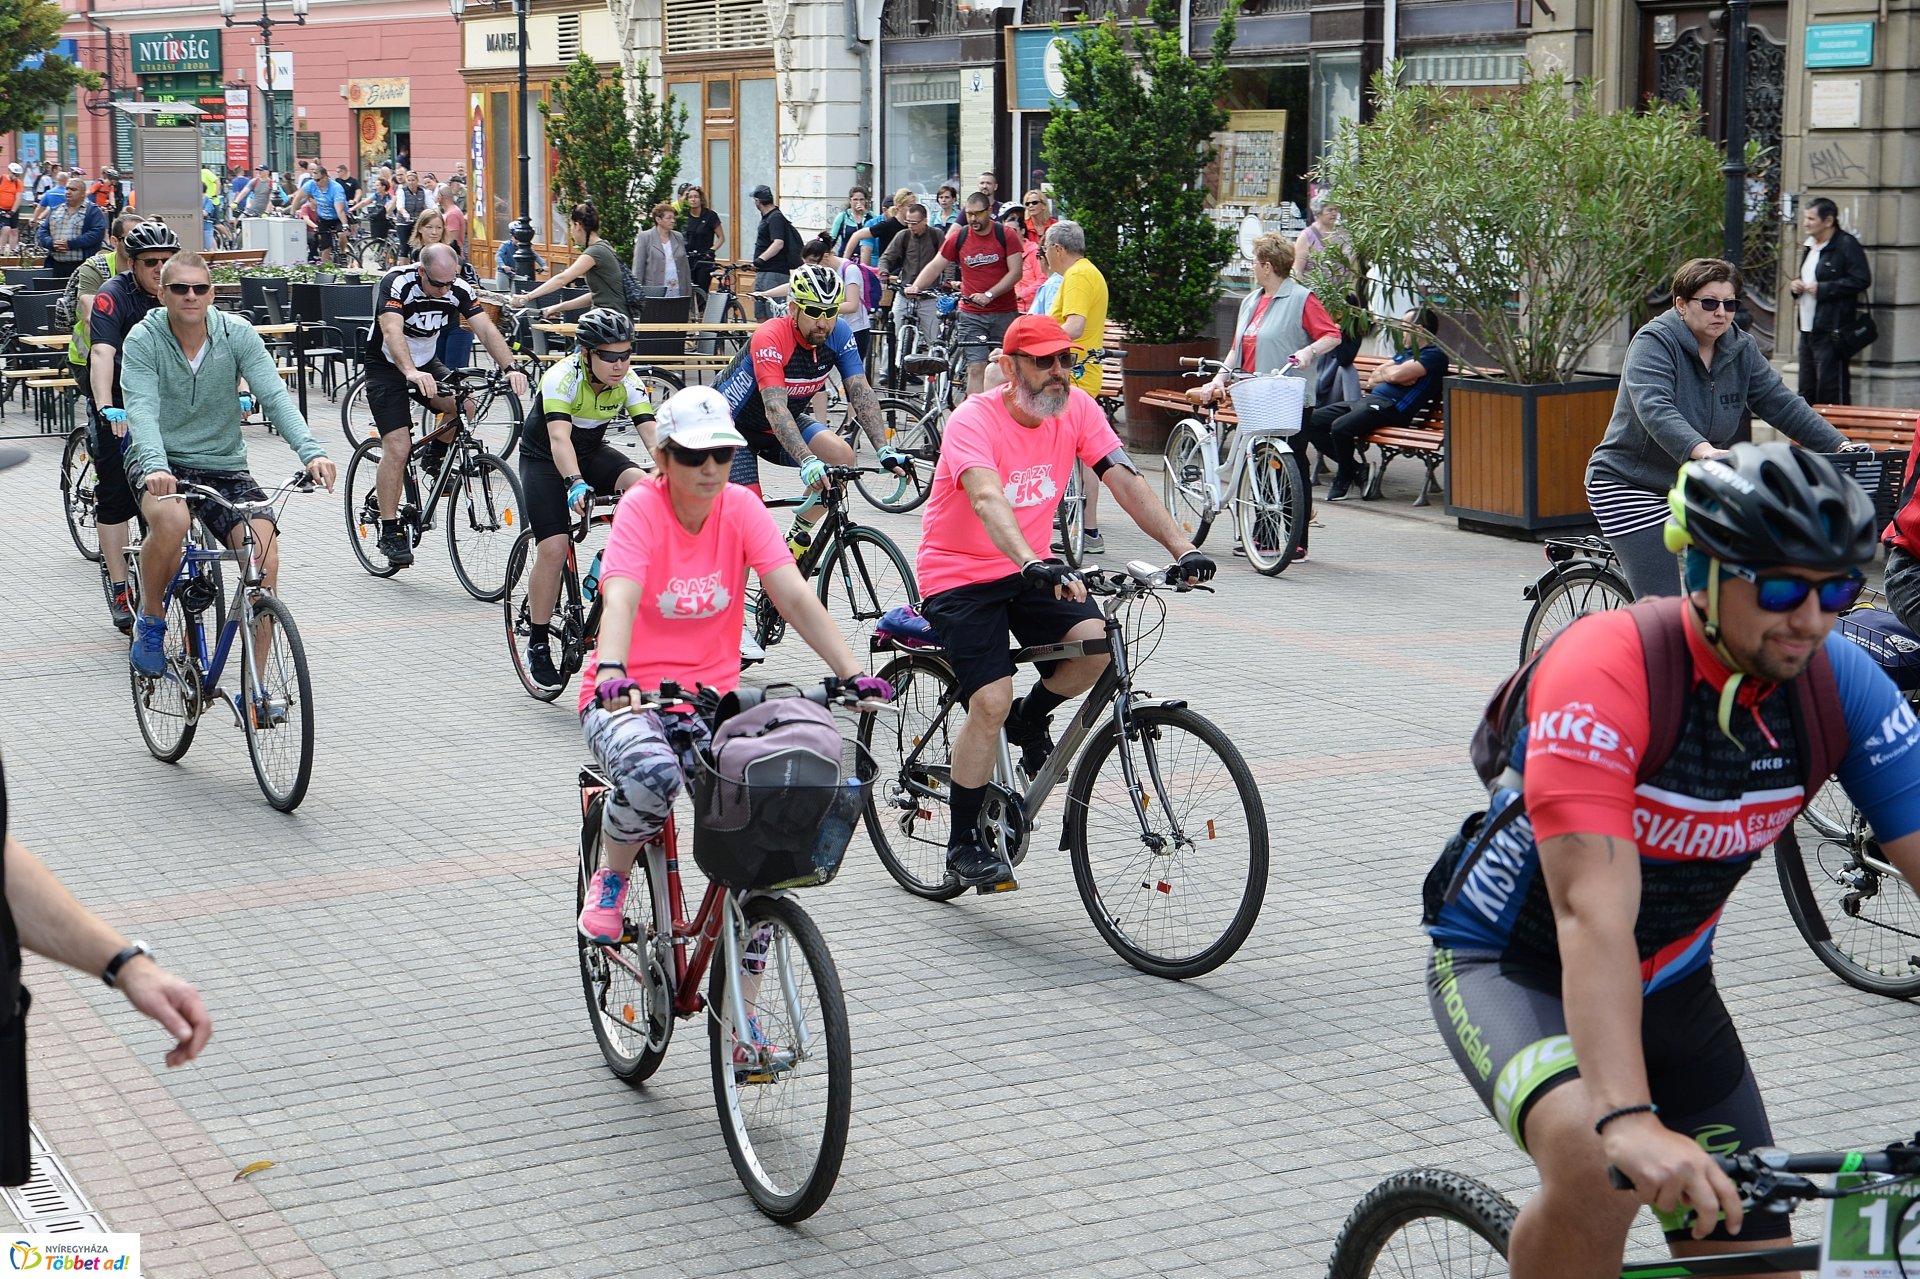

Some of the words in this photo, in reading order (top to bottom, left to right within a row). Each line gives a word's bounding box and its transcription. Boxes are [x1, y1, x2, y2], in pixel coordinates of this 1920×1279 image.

[139, 34, 210, 61] NYÍRSÉG
[487, 31, 532, 51] MARELA
[182, 62, 210, 71] IRODA
[405, 311, 449, 331] KTM
[1009, 464, 1052, 484] CRAZY
[1015, 479, 1043, 505] 5K
[673, 592, 716, 616] 5K
[1537, 711, 1620, 752] KKB
[1751, 756, 1784, 772] KKB
